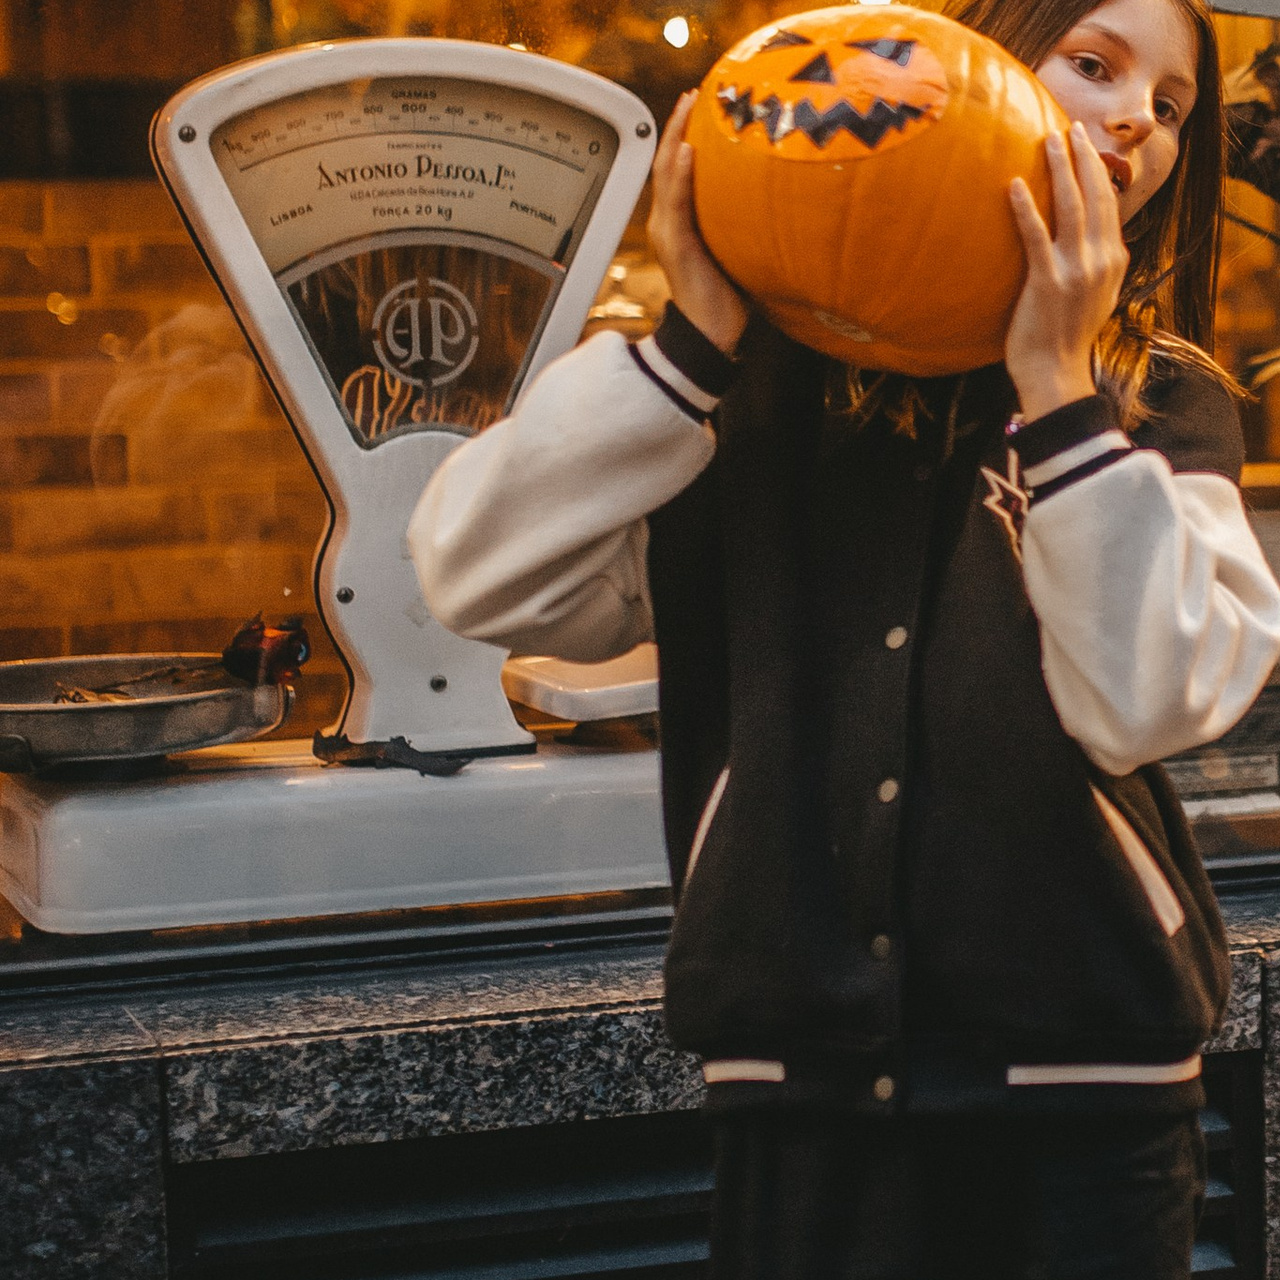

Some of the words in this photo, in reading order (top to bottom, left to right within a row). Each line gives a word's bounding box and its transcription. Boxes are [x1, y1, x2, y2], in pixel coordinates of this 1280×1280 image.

[401, 103, 427, 113] 500
[317, 160, 408, 191] ANTONIO
[269, 204, 313, 227] LISBOA
[415, 205, 433, 216] 20
[437, 205, 453, 221] kg
[509, 199, 558, 226] PORTUGAL
